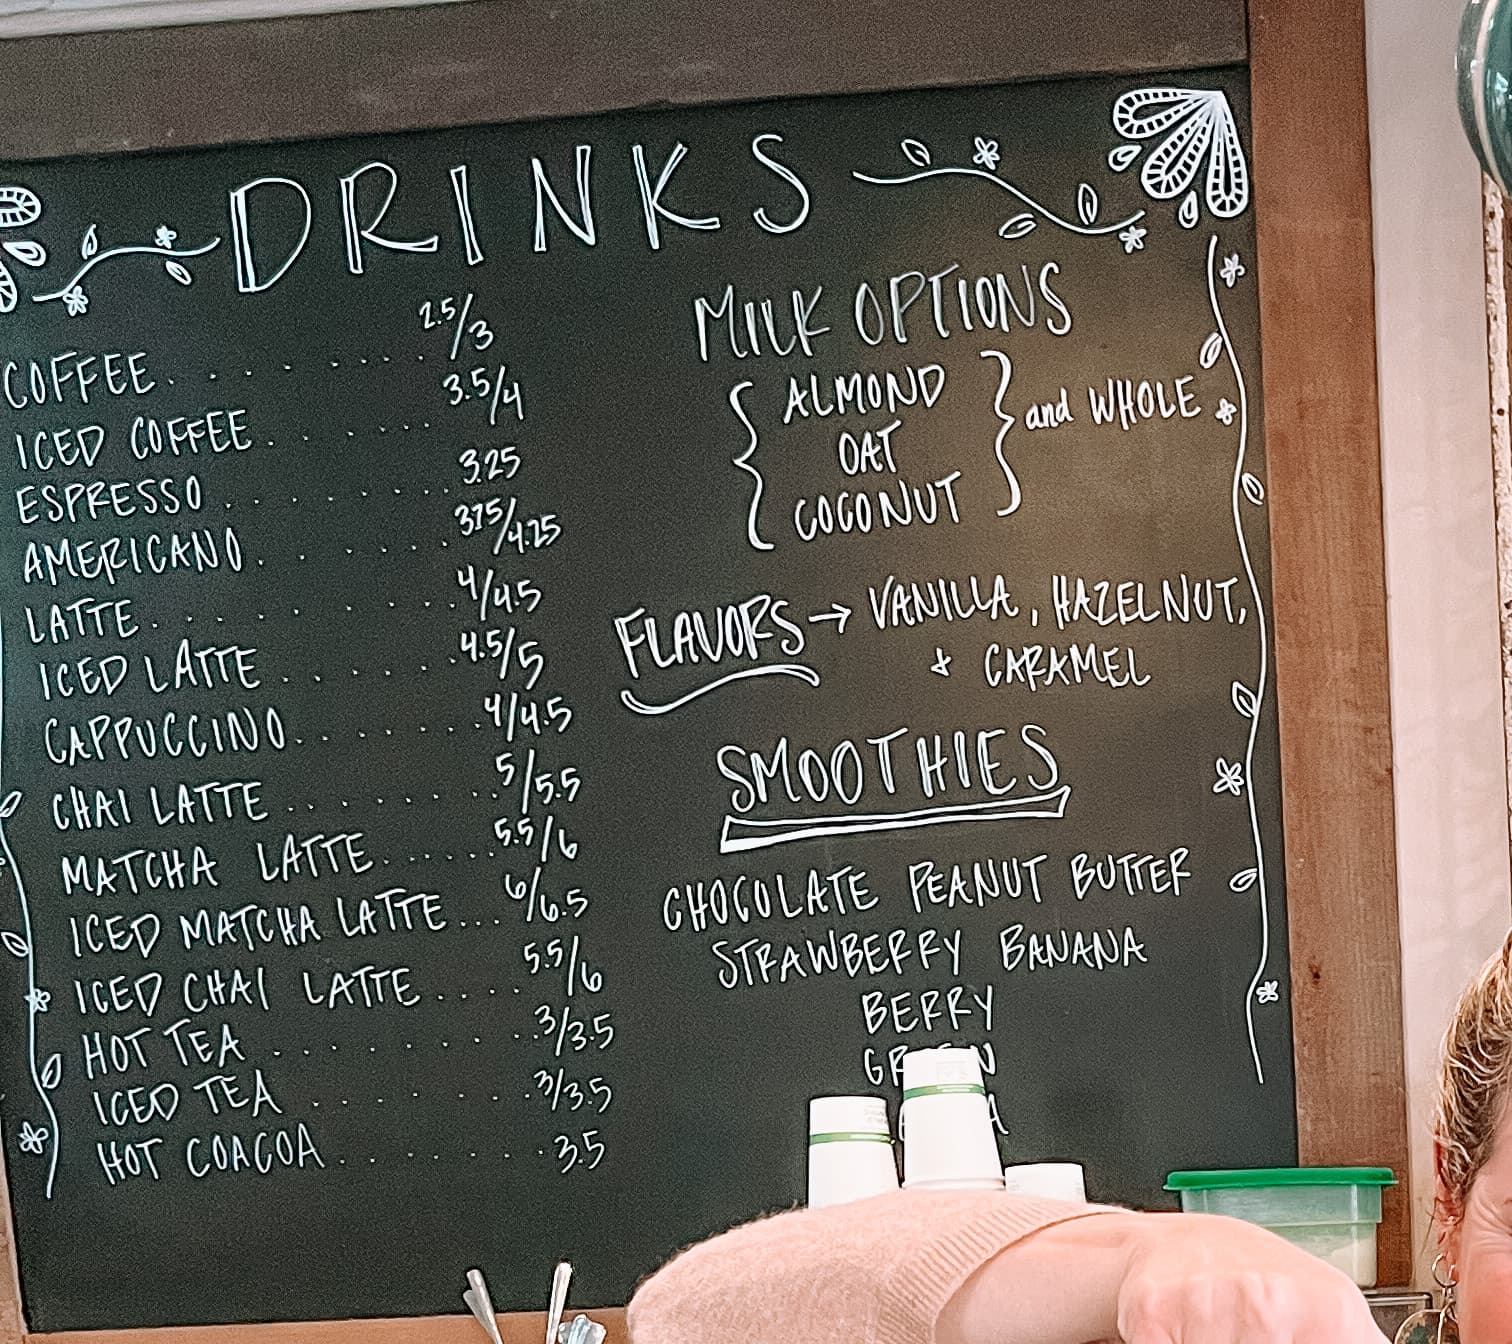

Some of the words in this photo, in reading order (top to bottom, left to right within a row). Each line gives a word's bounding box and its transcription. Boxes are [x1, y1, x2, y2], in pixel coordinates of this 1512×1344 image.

[230, 134, 809, 292] DRINKS
[695, 285, 830, 361] MILK
[856, 263, 1071, 345] OPTIONS
[3, 352, 155, 408] COFFEE
[784, 365, 944, 424] ALMOND
[1026, 387, 1074, 429] and
[1089, 375, 1201, 430] WHOLE
[16, 426, 104, 470] ICED
[131, 410, 251, 459] COFFEE
[839, 420, 901, 474] OAT
[17, 476, 200, 523] ESPRESSO
[460, 447, 520, 483] 3.25
[795, 471, 961, 540] COCONUT
[25, 528, 241, 585] AMERICANO
[25, 598, 138, 643] LATTE
[615, 595, 804, 678] FLAVORS
[40, 656, 127, 700] ICED
[144, 639, 260, 692] LATTE
[985, 643, 1151, 691] CARAMEL
[45, 708, 284, 766] CAPPUCCINO
[717, 725, 1057, 812] SMOOTHIES
[53, 786, 130, 829] CHAI
[151, 782, 268, 824] LATTE
[62, 847, 218, 896] MATCHA
[257, 833, 373, 881] LATTE
[909, 855, 1047, 913] PEANUT
[1071, 848, 1191, 899] BUTTER
[70, 914, 159, 957] ICED
[180, 905, 320, 950] MATCHA
[337, 889, 446, 936] LATTE
[712, 930, 960, 988] STRAWBERRY
[1000, 924, 1147, 970] BANANA
[75, 973, 162, 1016] ICED
[184, 968, 268, 1012] CHAI
[304, 966, 420, 1008] LATTE
[862, 985, 992, 1034] BERRY
[82, 1028, 151, 1079] HOT
[164, 1019, 245, 1067] TEA
[863, 1042, 996, 1087] GRN
[94, 1084, 178, 1125] ICED
[193, 1070, 282, 1116] TEA
[97, 1138, 162, 1184] HOT
[187, 1123, 324, 1177] COACOA
[555, 1131, 604, 1173] 3.5
